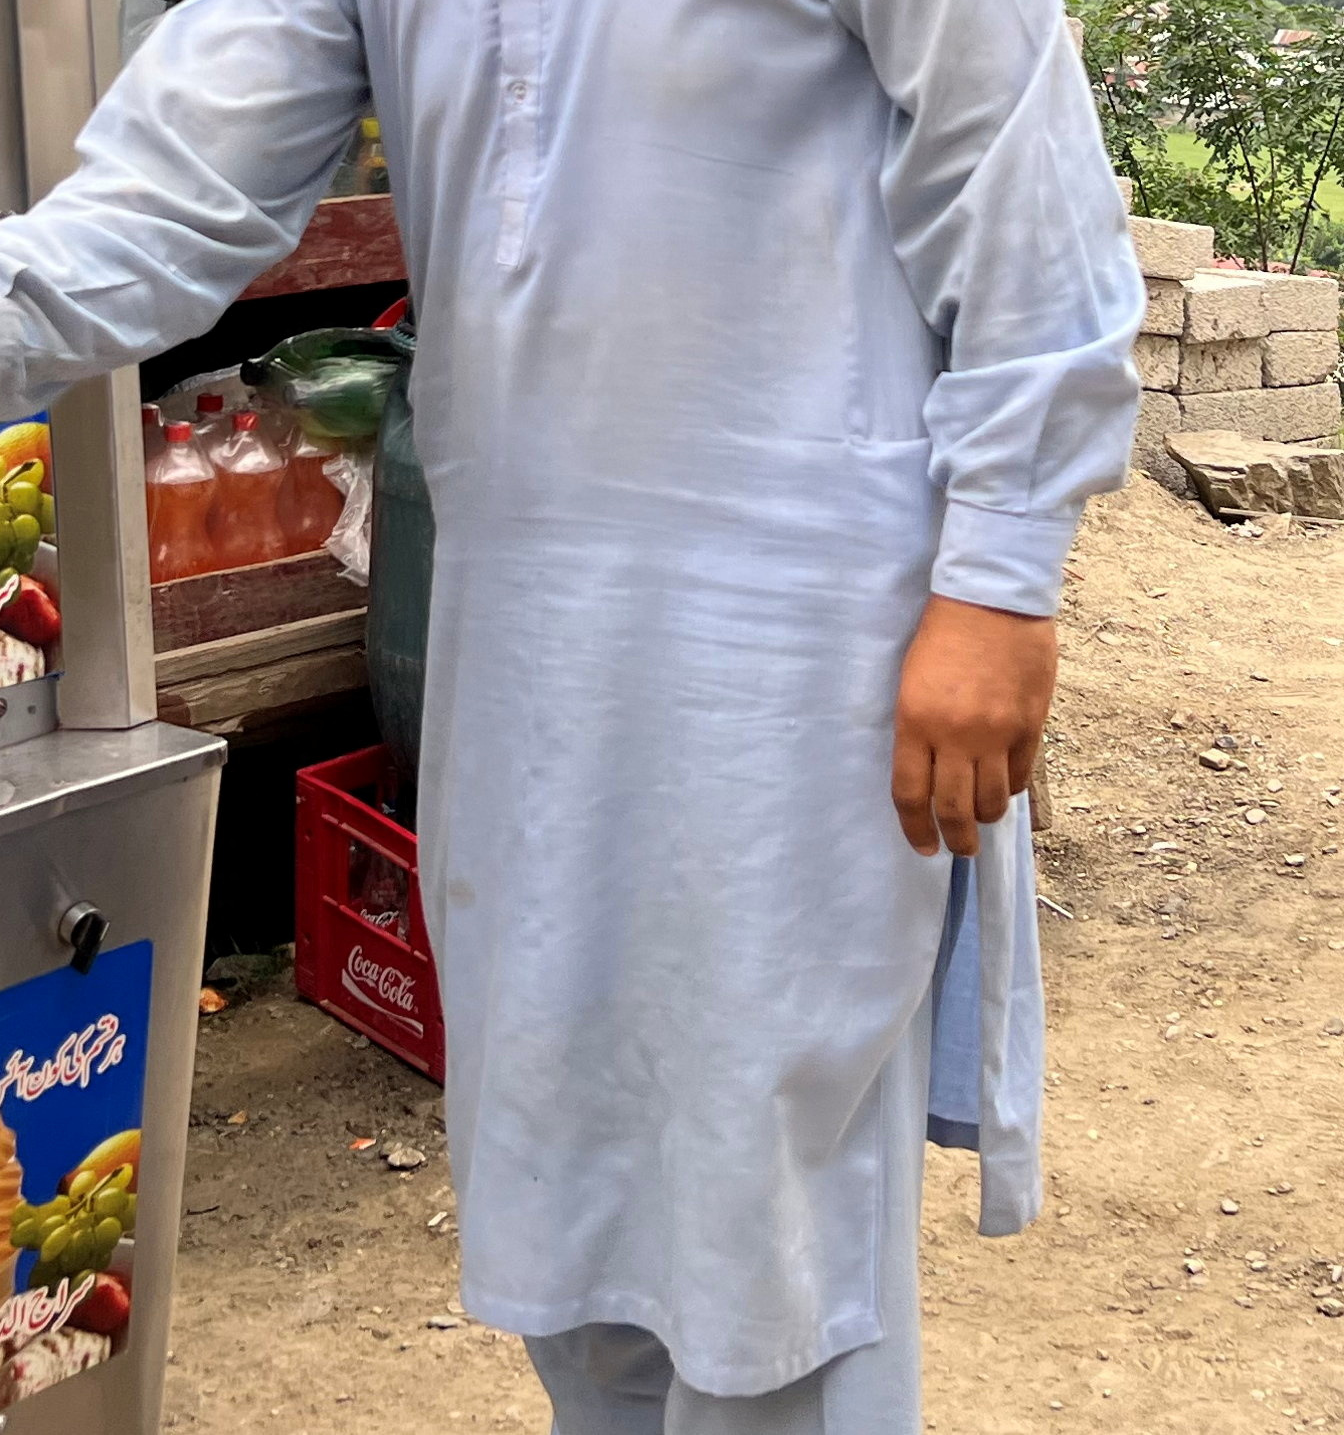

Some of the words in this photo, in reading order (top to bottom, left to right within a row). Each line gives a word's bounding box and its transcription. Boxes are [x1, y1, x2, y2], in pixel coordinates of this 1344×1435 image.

[347, 944, 416, 1012] Coca-Cola
[23, 1033, 78, 1101] کون
[61, 1024, 96, 1086] کی
[80, 1013, 119, 1089] قسم
[97, 1034, 127, 1075] ہر
[28, 1273, 96, 1333] سراج
